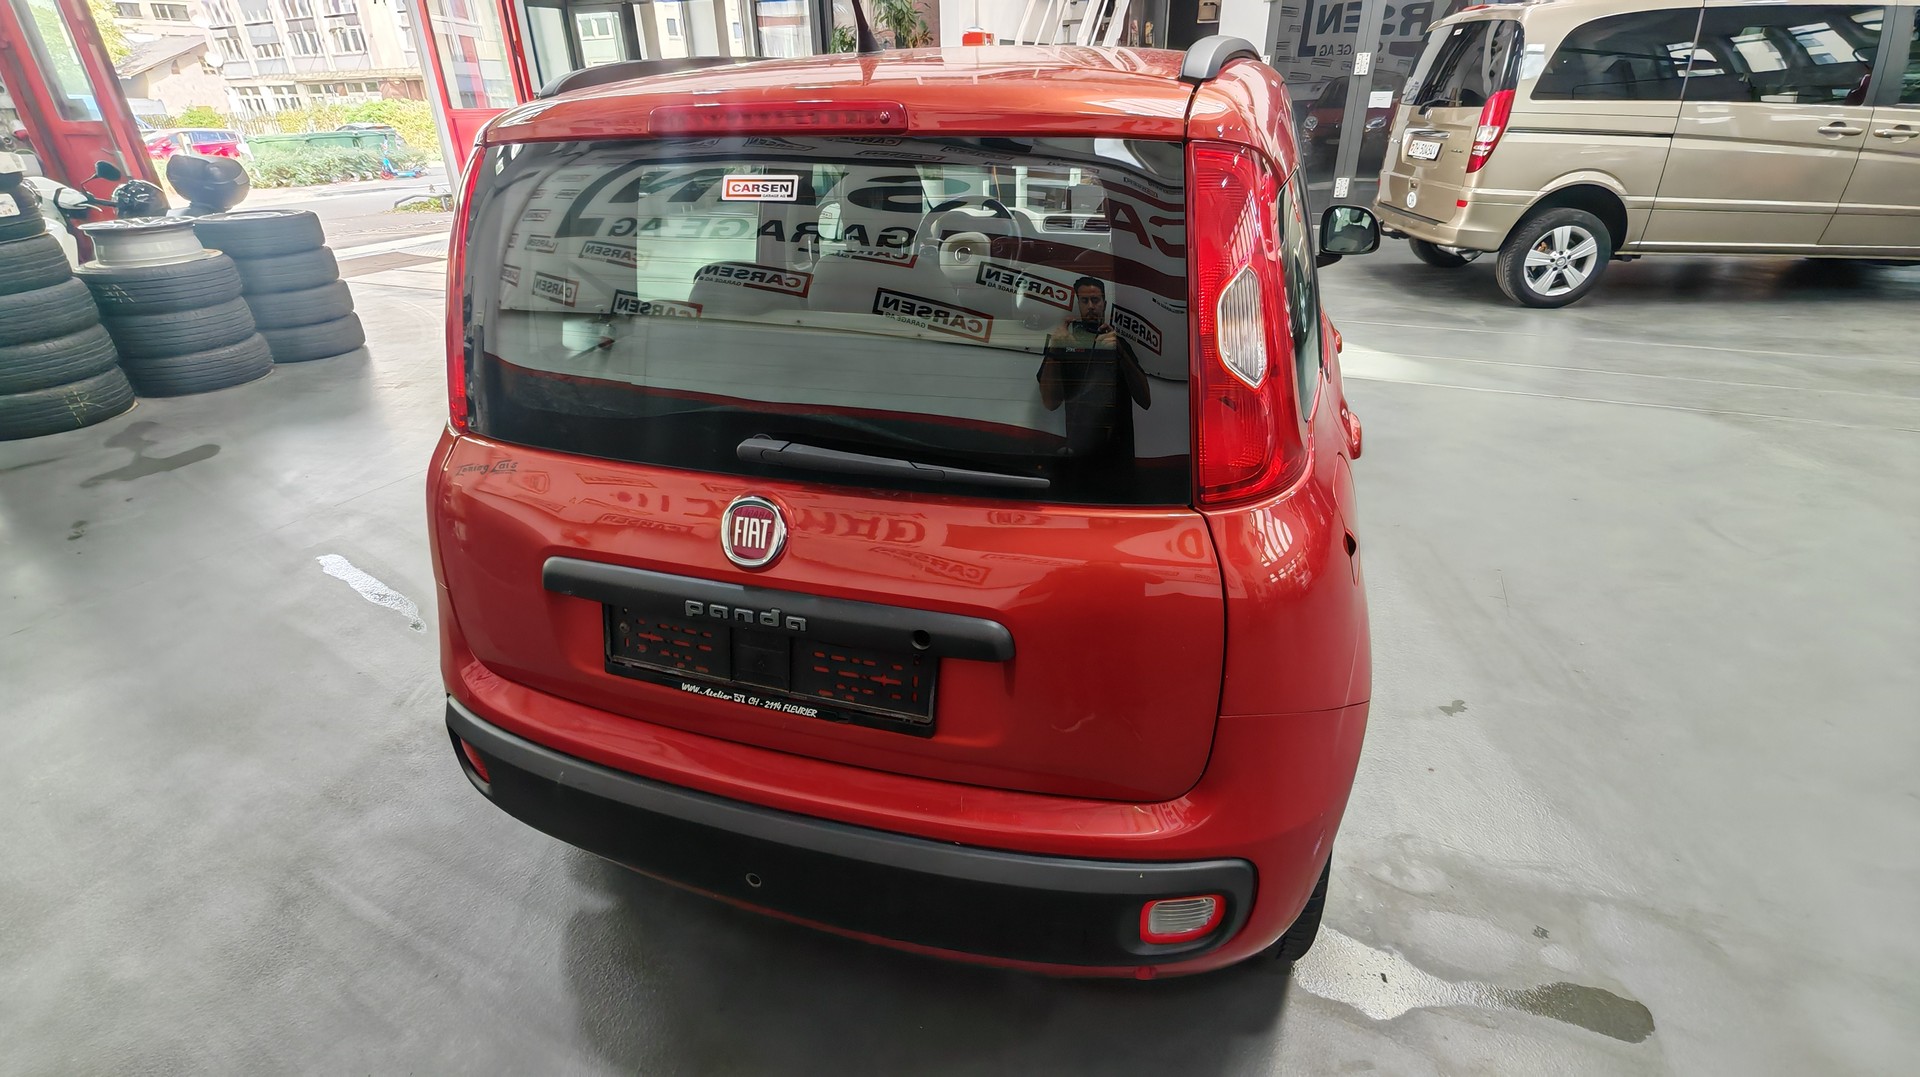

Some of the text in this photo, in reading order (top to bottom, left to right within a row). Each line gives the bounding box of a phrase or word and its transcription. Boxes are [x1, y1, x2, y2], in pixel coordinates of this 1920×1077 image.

[731, 183, 789, 193] CARSEN
[734, 516, 772, 549] FIAT
[685, 600, 806, 632] panda
[748, 697, 760, 707] CH
[764, 700, 781, 712] 2114
[782, 703, 819, 718] FLEURIER
